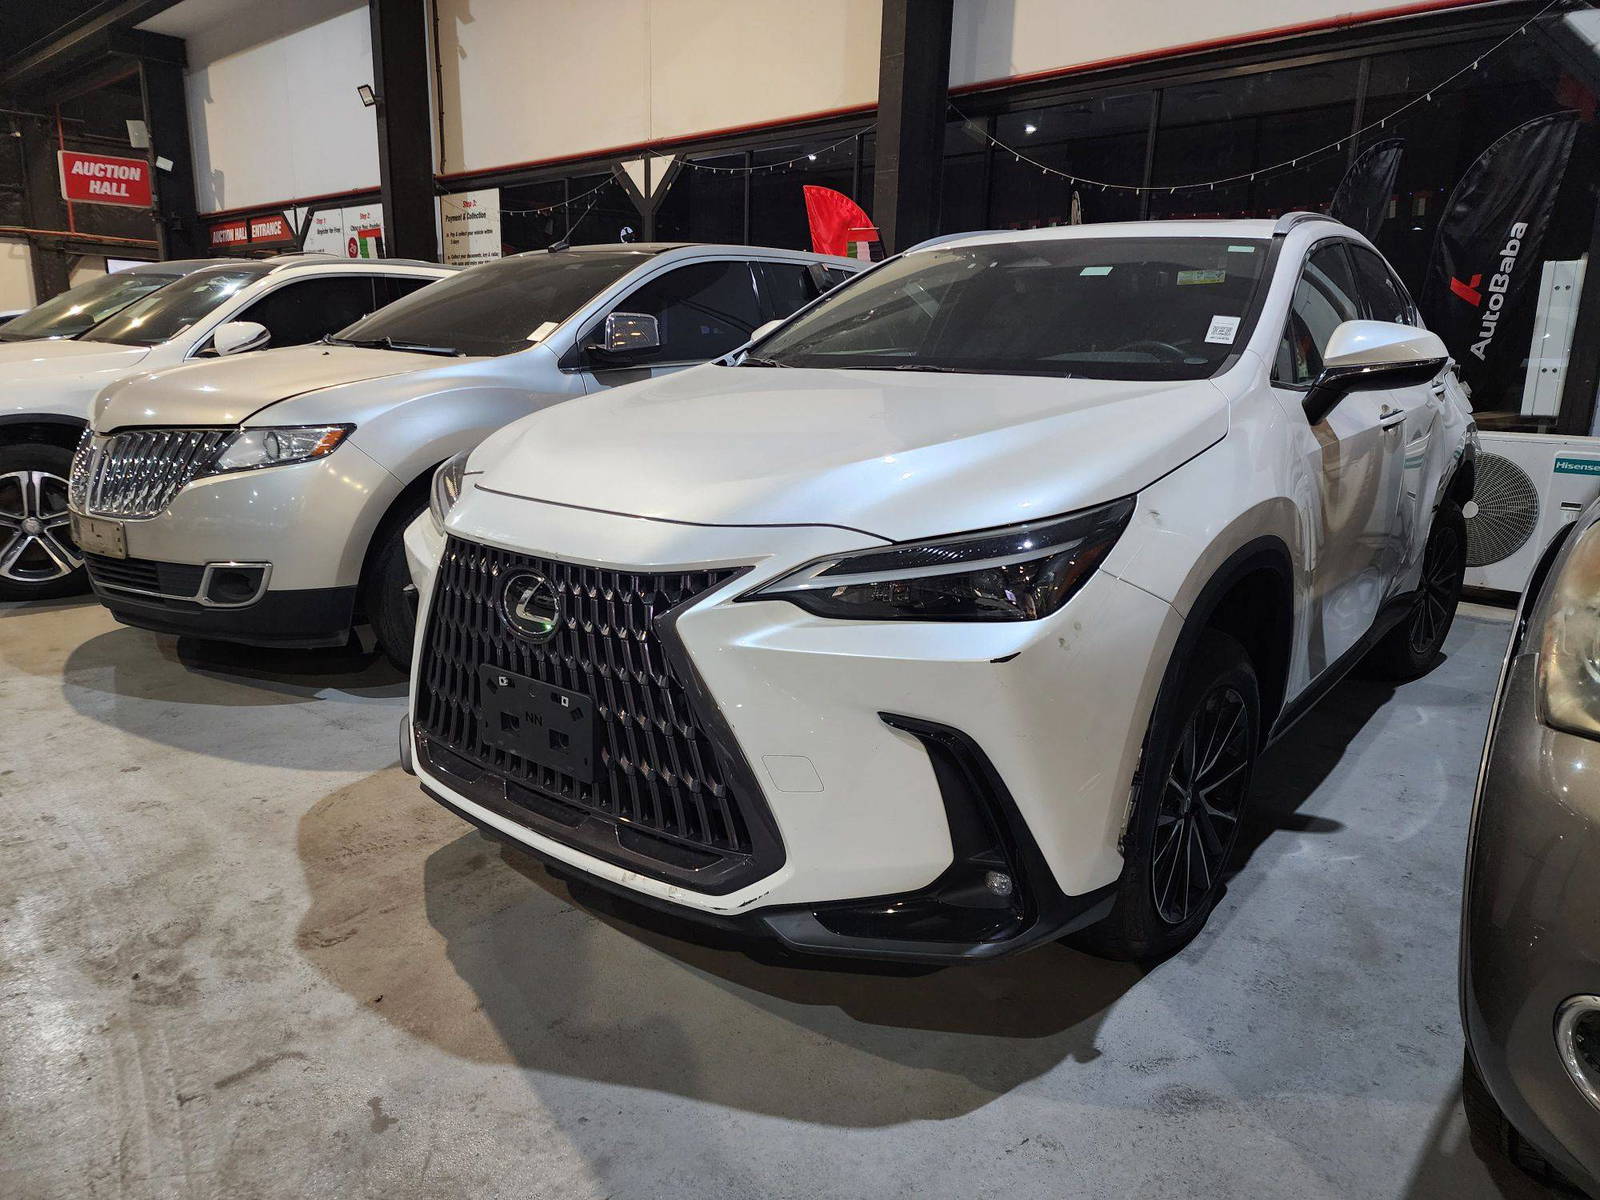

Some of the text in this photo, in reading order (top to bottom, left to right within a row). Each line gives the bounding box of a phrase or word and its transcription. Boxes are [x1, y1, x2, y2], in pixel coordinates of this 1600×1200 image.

[72, 160, 141, 181] AUCTION
[89, 180, 129, 197] HALL
[446, 214, 462, 222] Payment
[467, 212, 486, 220] Collection
[213, 229, 234, 243] AUCTION
[252, 221, 281, 238] ENTRANCE
[1470, 222, 1528, 361] AutoBaba
[1556, 461, 1600, 472] Hisense
